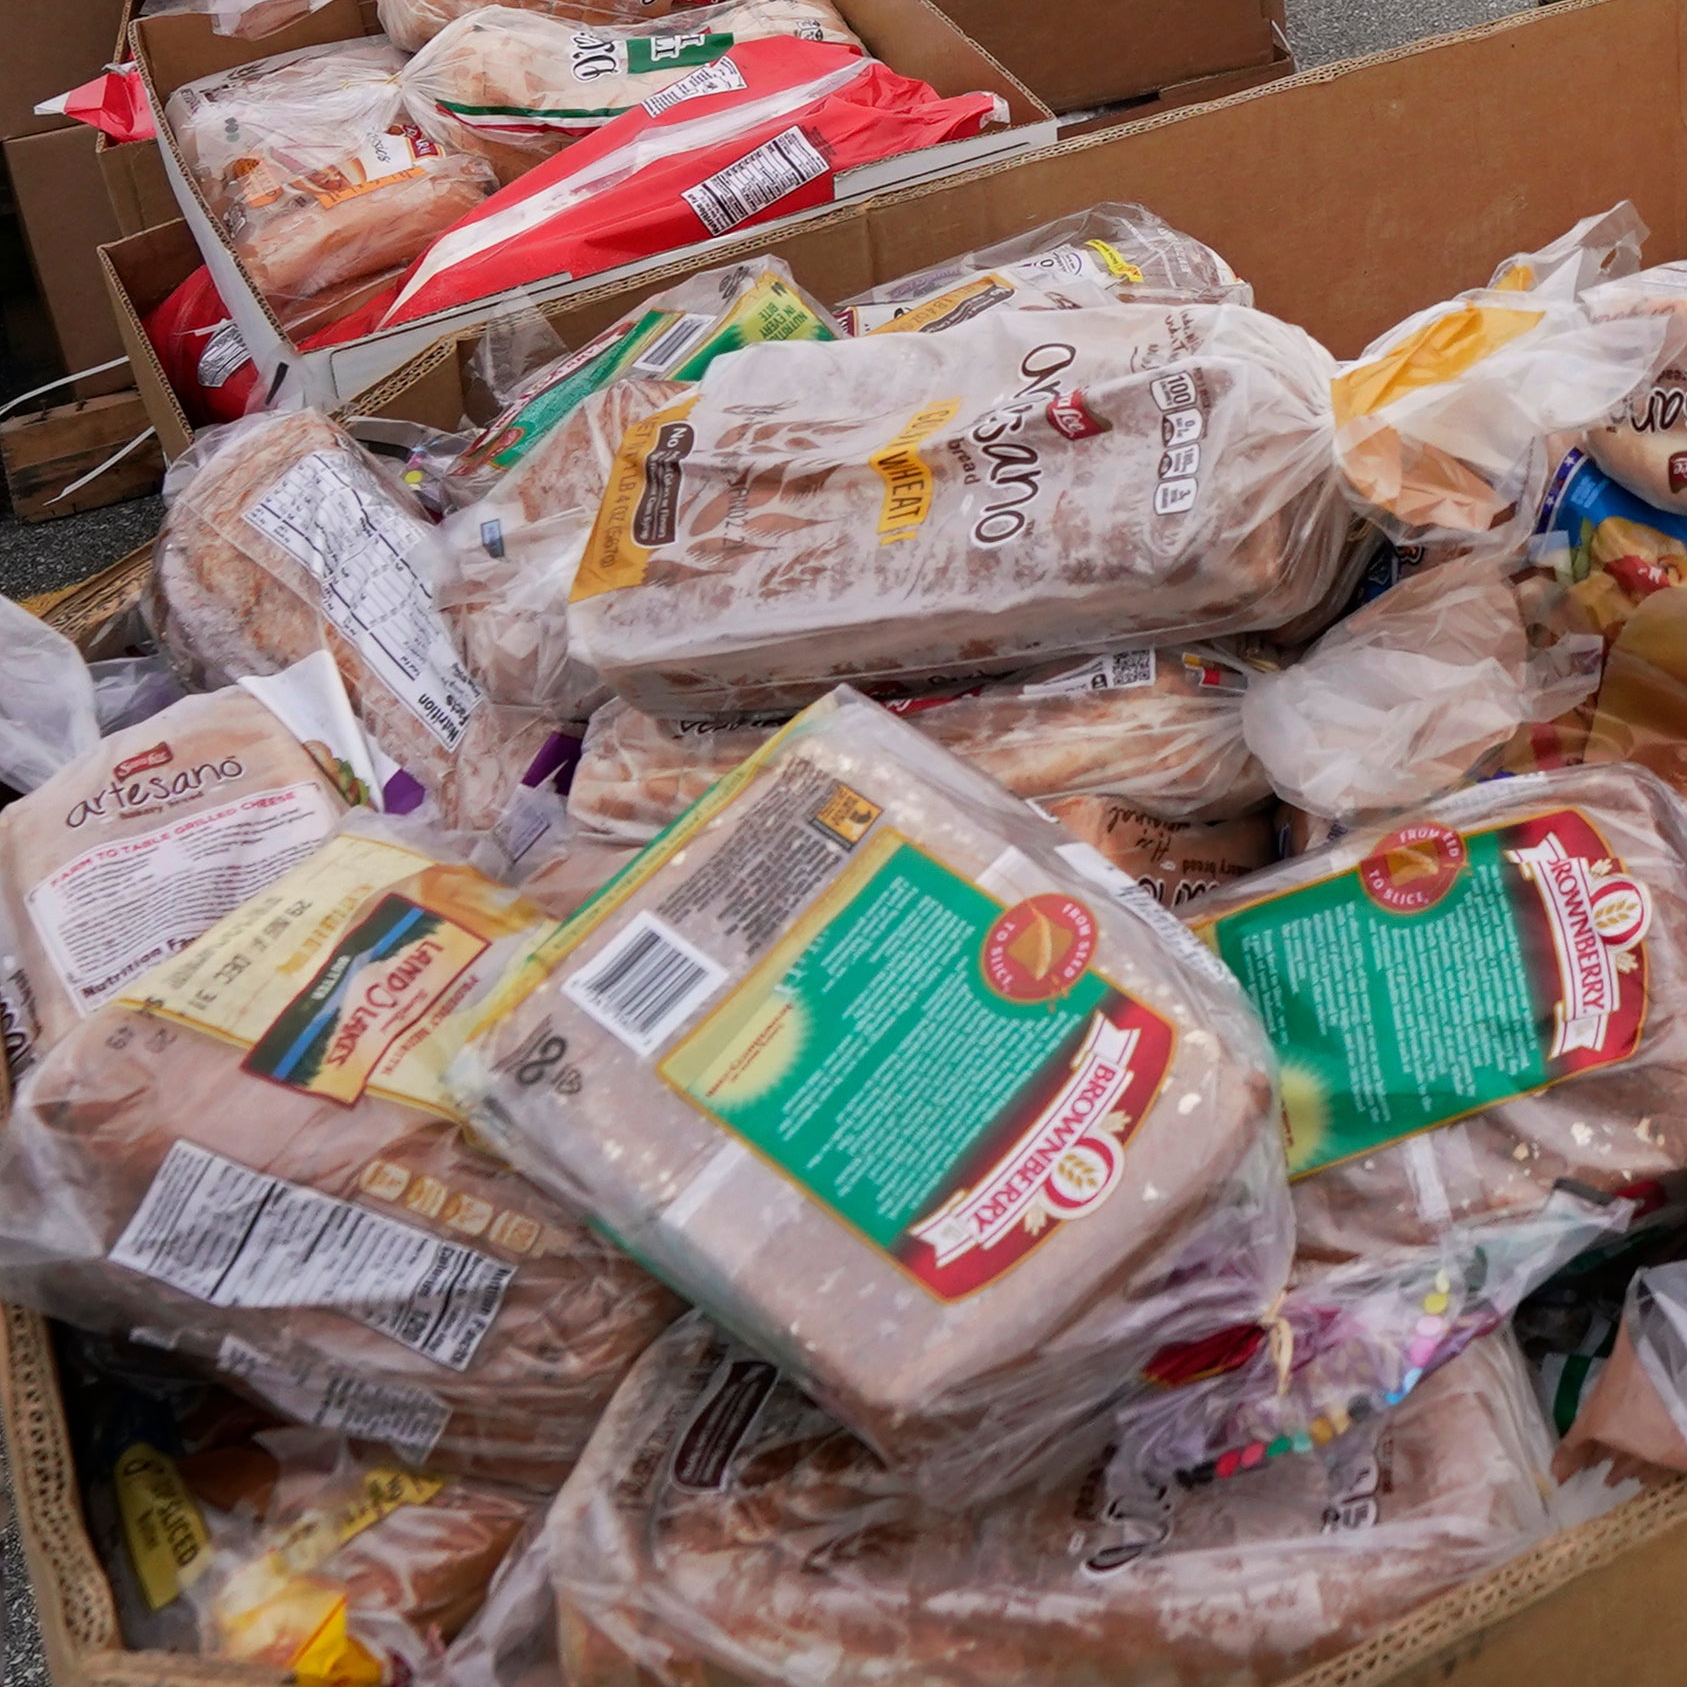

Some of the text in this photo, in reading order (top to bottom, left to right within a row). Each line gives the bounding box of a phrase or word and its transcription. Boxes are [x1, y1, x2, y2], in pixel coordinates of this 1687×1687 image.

[756, 301, 780, 322] BITE
[757, 304, 796, 340] IN EVERY
[1167, 375, 1192, 405] 100
[666, 427, 687, 447] No
[948, 436, 982, 485] bread
[876, 450, 928, 521] WHEAT
[640, 516, 653, 539] Syrup
[657, 509, 670, 538] Flavors
[414, 693, 462, 742] Nutrition
[51, 792, 295, 886] FARM TO TABLE GRILLED CHEESE
[1398, 826, 1443, 845] FROM
[1383, 884, 1430, 908] SLICE
[1060, 900, 1095, 980] FROM SEED
[82, 948, 163, 999] Nutrition
[212, 952, 252, 987] DEC
[308, 951, 352, 1003] BUTTER
[384, 937, 444, 996] LAND
[992, 947, 1012, 987] SLICE
[323, 1003, 377, 1072] LAKES
[969, 1061, 1117, 1234] BROWNBERRY
